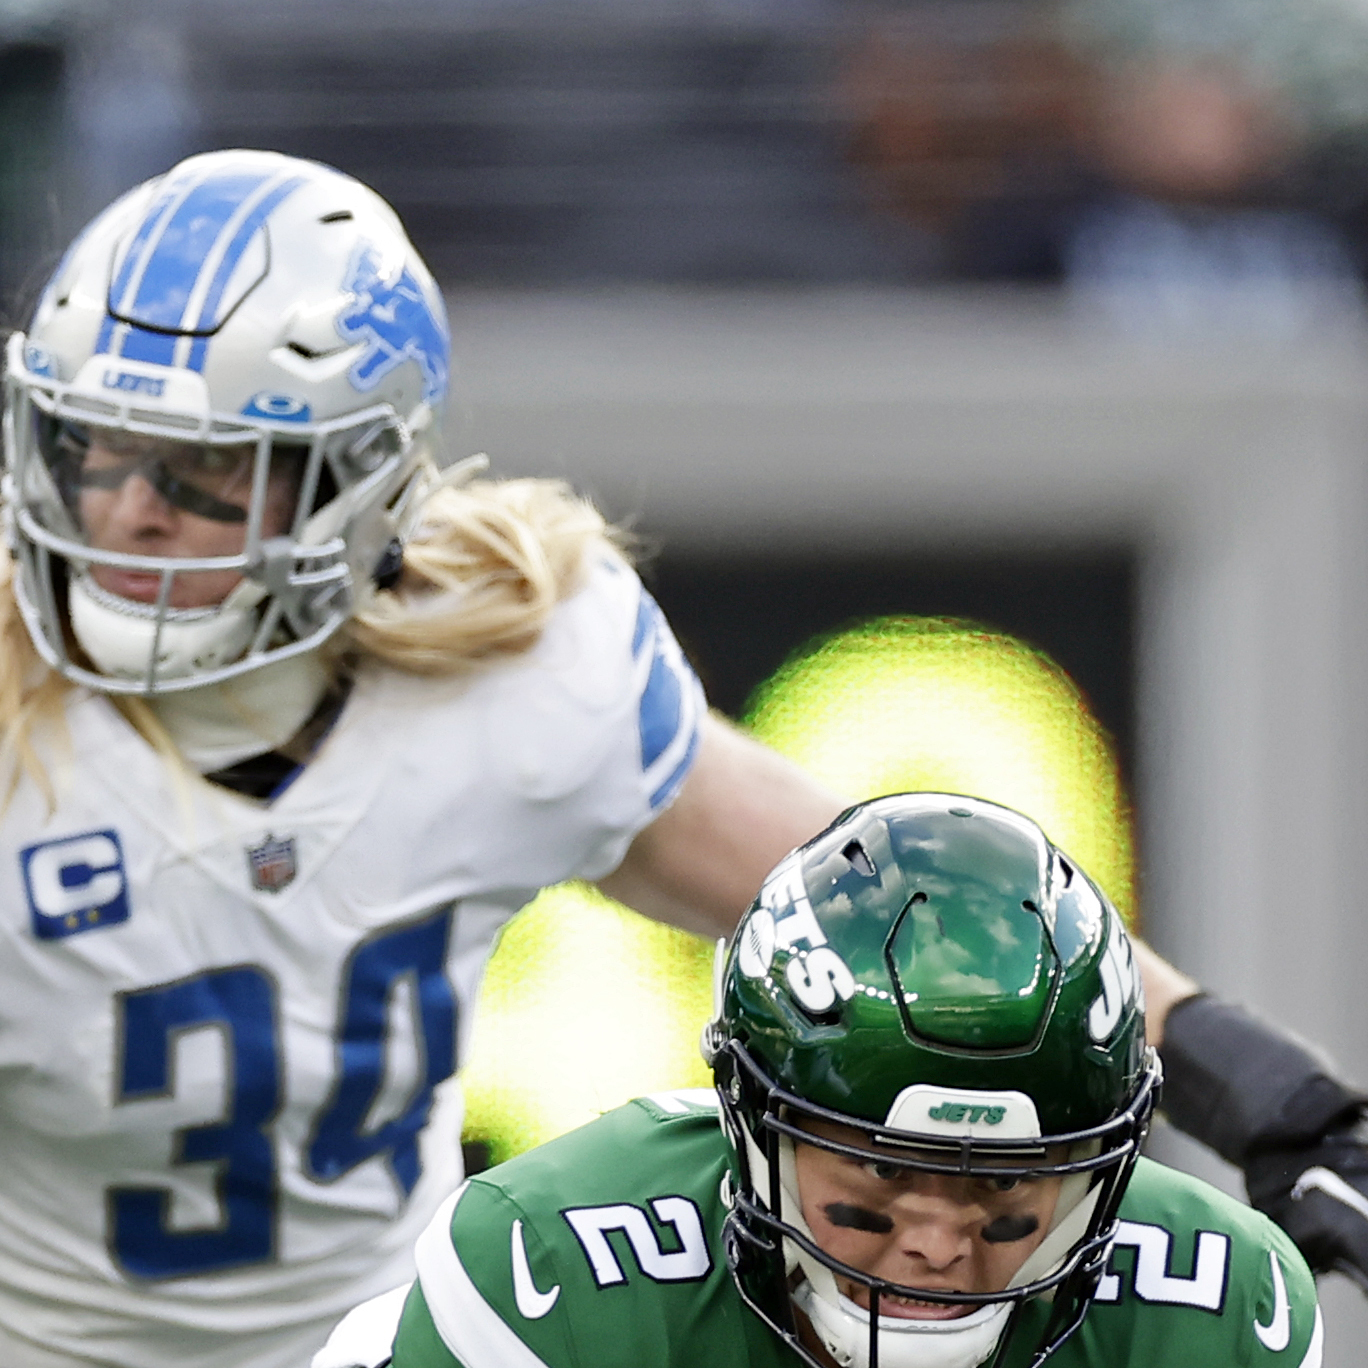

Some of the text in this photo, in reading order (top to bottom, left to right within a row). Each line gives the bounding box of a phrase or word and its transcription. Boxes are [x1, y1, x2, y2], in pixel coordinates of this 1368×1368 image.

[29, 835, 123, 917] C
[106, 901, 459, 1281] 34
[928, 1101, 1007, 1125] JETS
[558, 1194, 714, 1291] 2
[1091, 1217, 1232, 1317] 2
